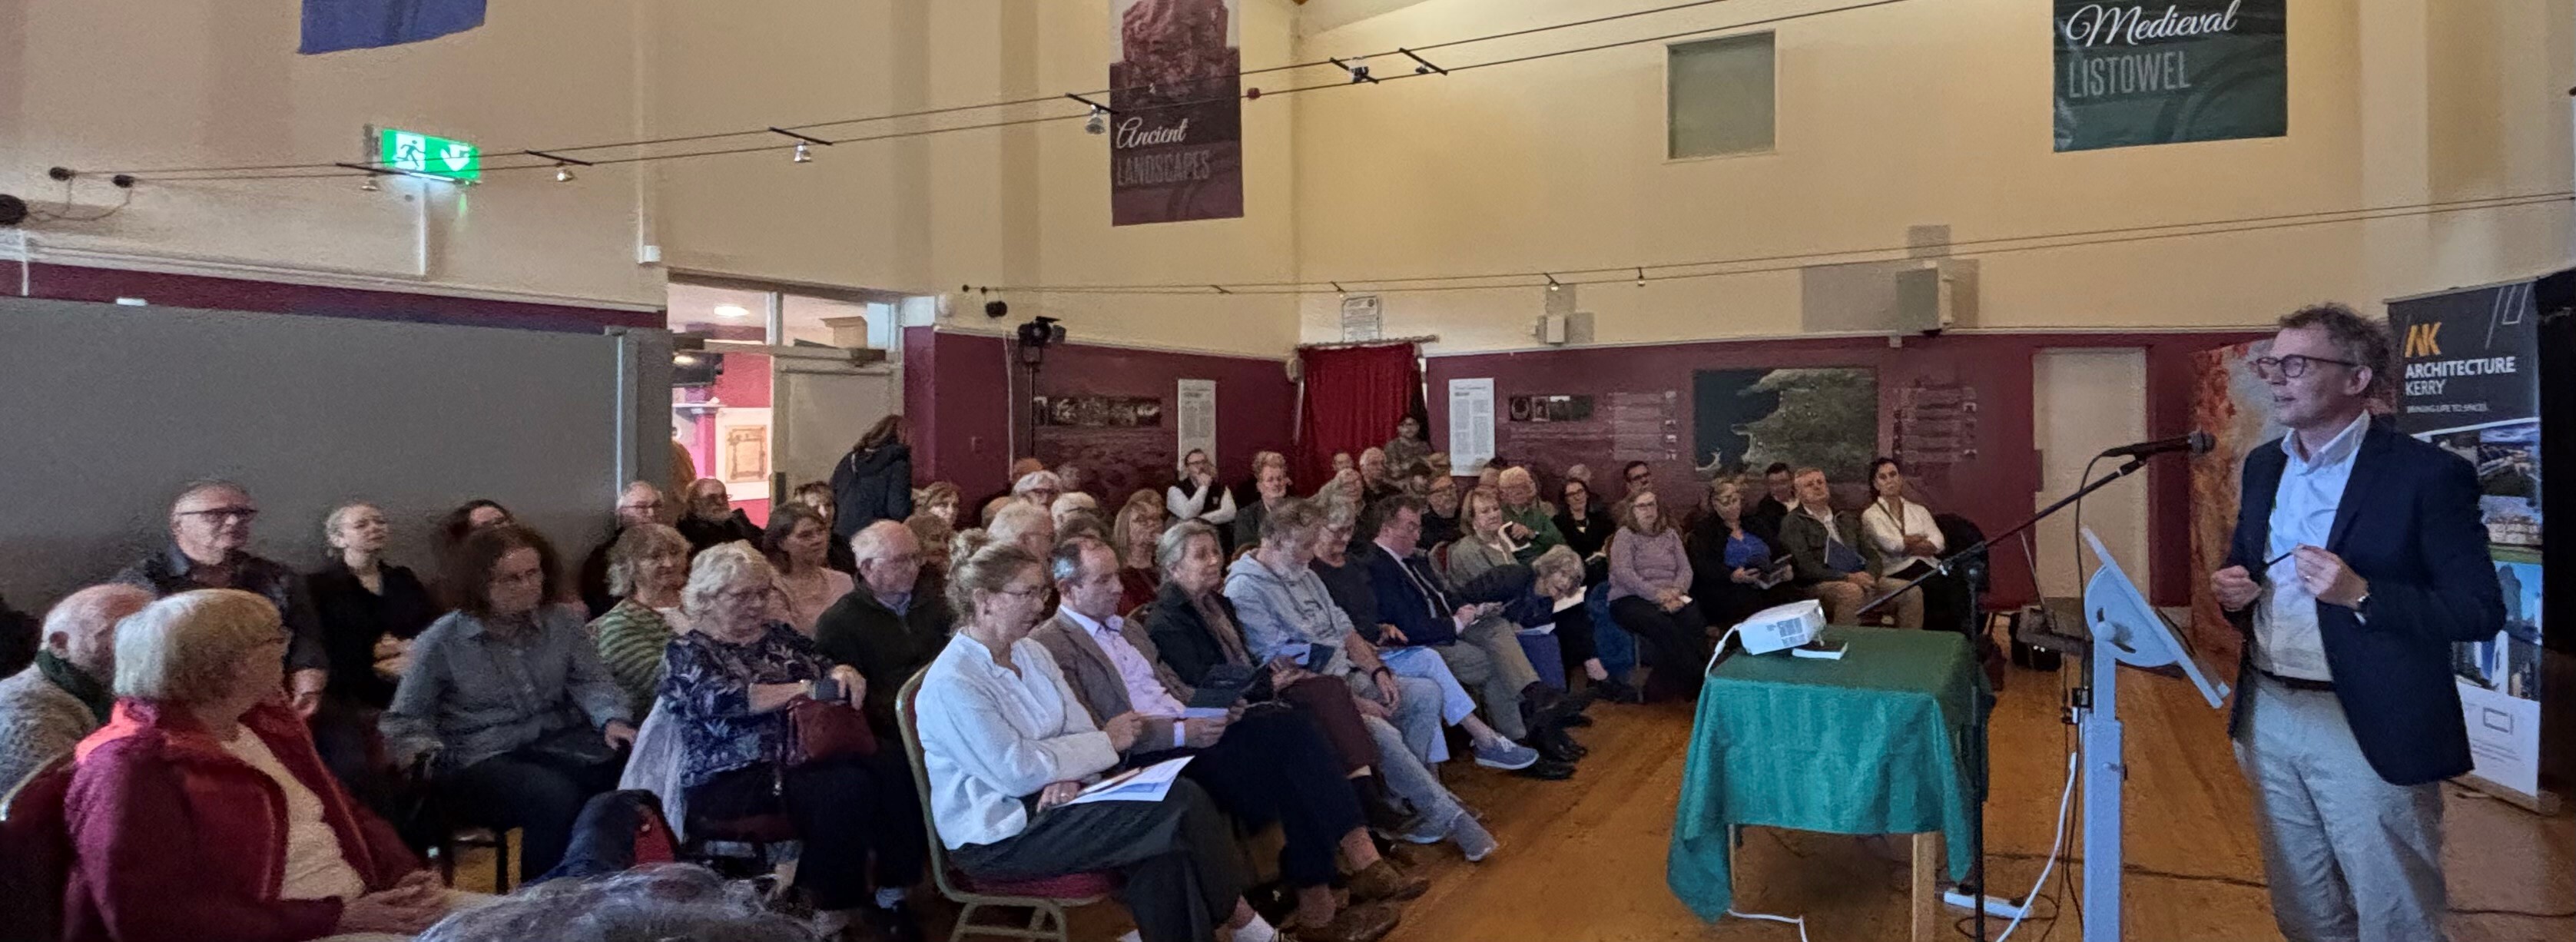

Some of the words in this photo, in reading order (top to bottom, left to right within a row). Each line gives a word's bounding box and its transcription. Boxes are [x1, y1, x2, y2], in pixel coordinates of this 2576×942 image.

[2066, 0, 2242, 47] Medieval
[2068, 51, 2191, 98] LISTOWEL
[1116, 116, 1189, 149] Ancient
[1117, 150, 1211, 186] LANDSCAPES
[2405, 356, 2517, 380] ARCHITECTURE
[2405, 380, 2447, 396] KERRY
